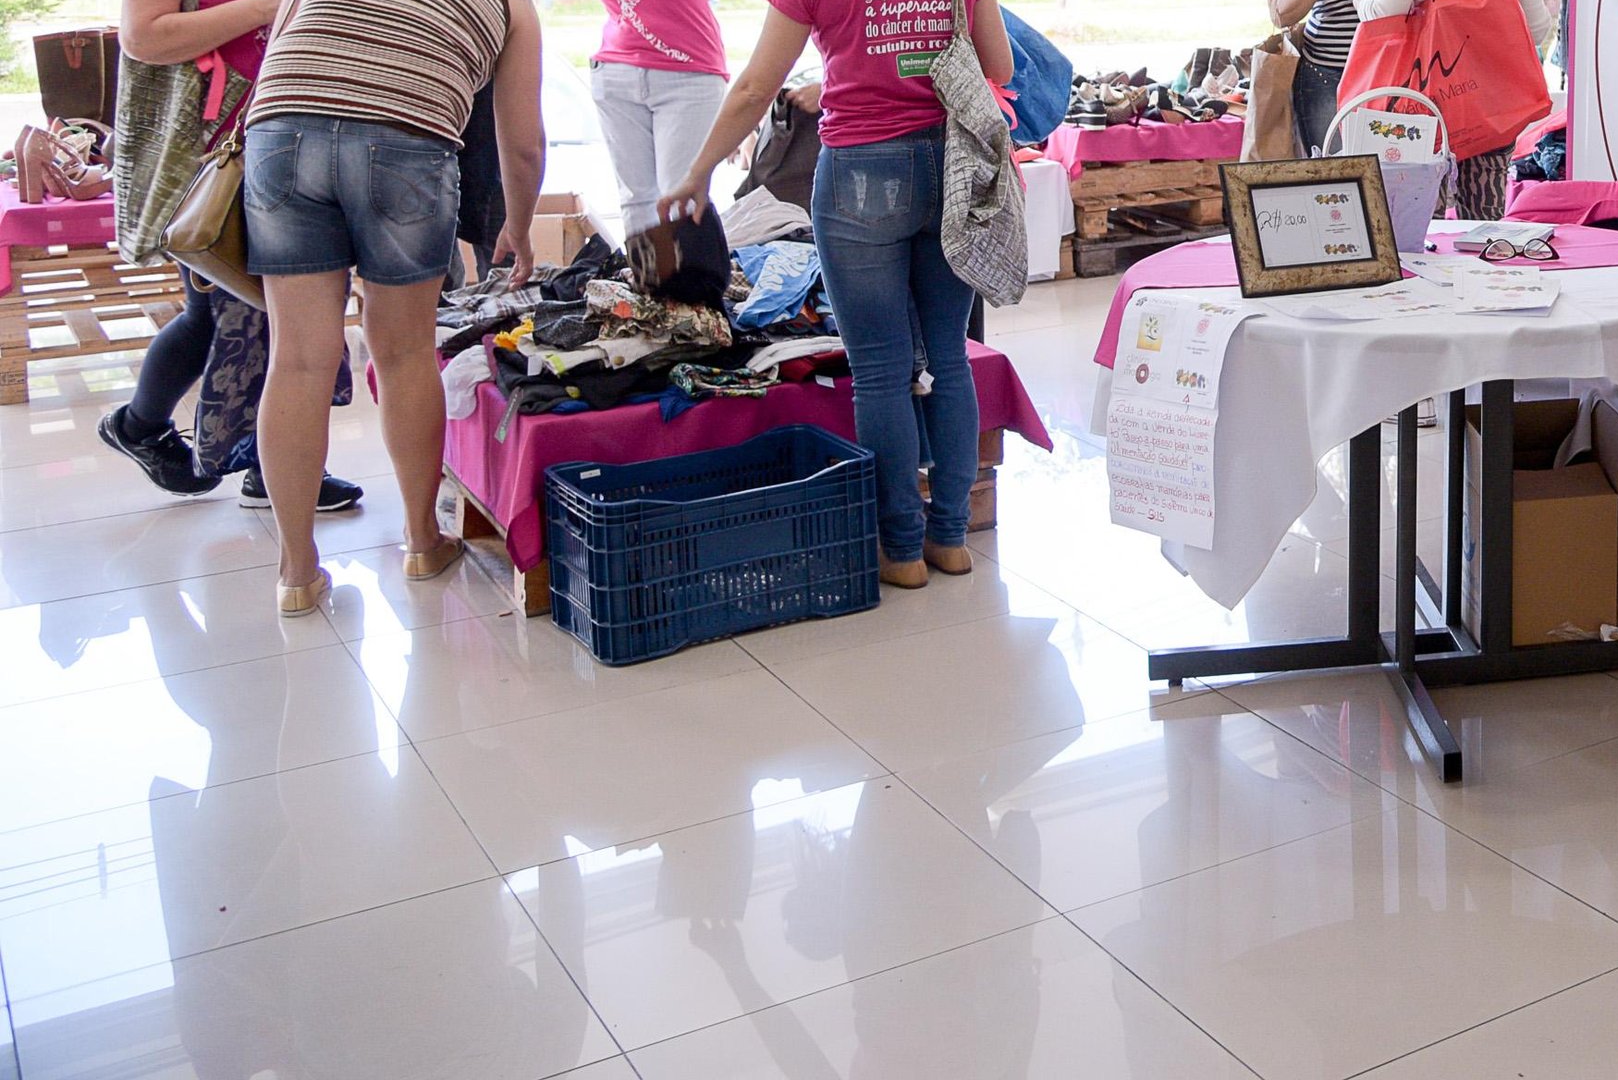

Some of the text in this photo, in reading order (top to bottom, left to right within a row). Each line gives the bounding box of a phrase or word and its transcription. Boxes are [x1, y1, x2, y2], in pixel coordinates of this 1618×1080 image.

[865, 5, 877, 18] a
[866, 20, 879, 38] do
[881, 17, 912, 36] câncer
[914, 16, 926, 32] de
[866, 40, 926, 56] outubro
[900, 58, 931, 68] Unimed
[1439, 77, 1480, 102] Maria
[1285, 214, 1306, 226] 20,00
[1121, 419, 1140, 428] com
